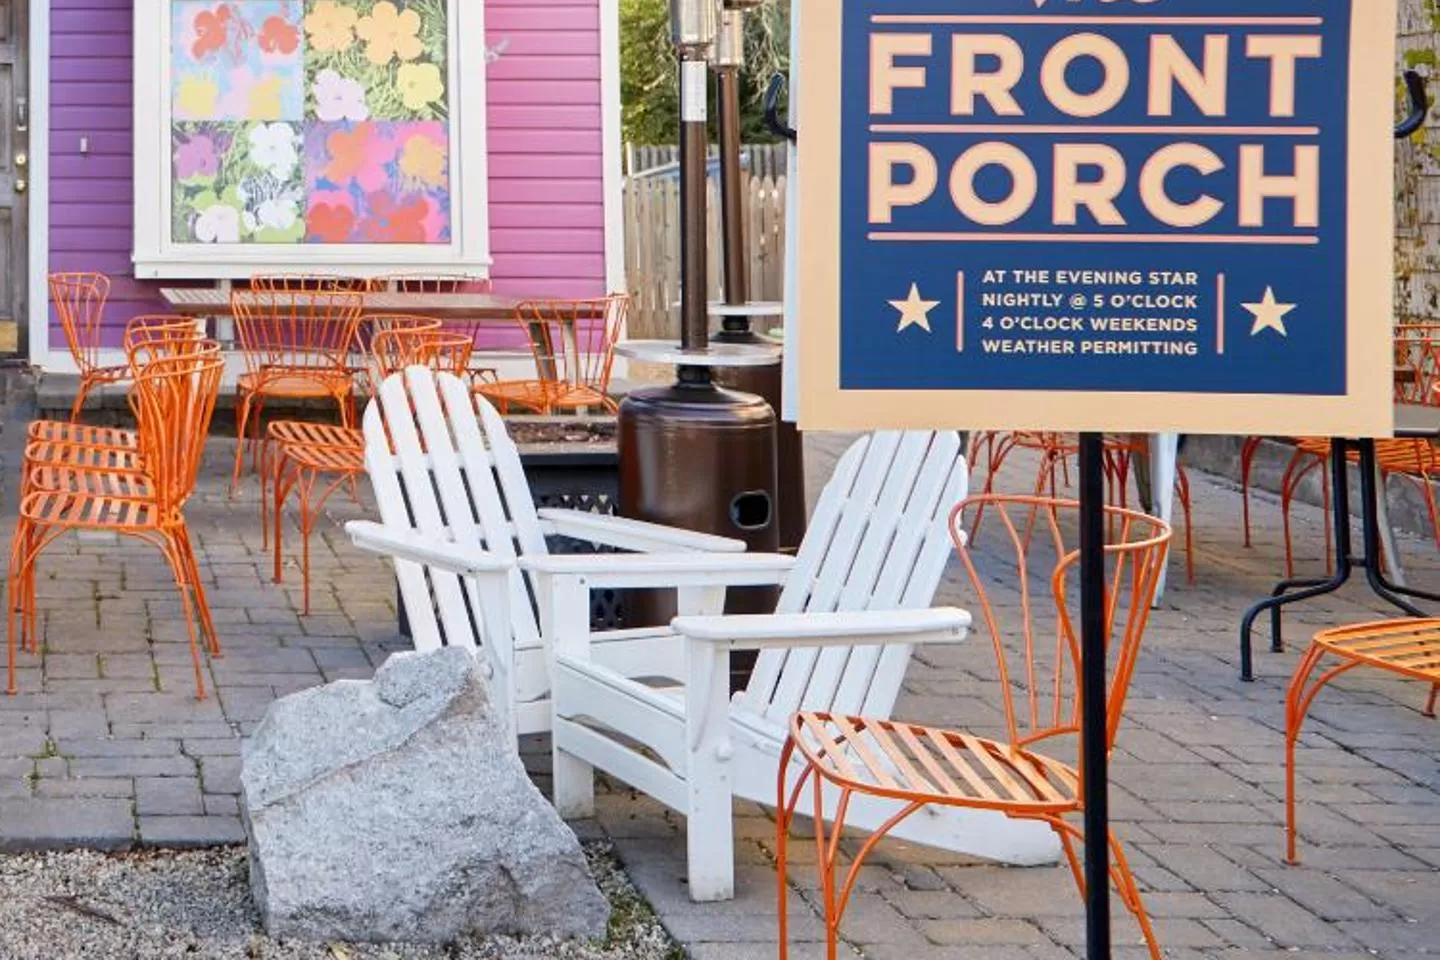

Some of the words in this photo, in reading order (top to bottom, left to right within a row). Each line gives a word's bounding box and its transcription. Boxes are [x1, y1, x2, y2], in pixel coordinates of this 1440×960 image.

[868, 32, 1323, 118] FRONT
[867, 141, 1321, 228] PORCH
[982, 270, 1006, 284] AT
[1012, 270, 1049, 284] THE
[1055, 271, 1142, 285] EVENING
[1148, 271, 1198, 285] STAR
[982, 293, 1063, 307] NIGHTLY
[1069, 293, 1087, 310] @
[1093, 294, 1105, 307] 5
[1111, 294, 1198, 308] O'CLOCK
[981, 316, 994, 330] 4
[1000, 316, 1084, 330] O'CLOCK
[1089, 318, 1198, 332] WEEKENDS
[982, 339, 1074, 354] WEATHER
[1081, 341, 1198, 355] PERMITTING
